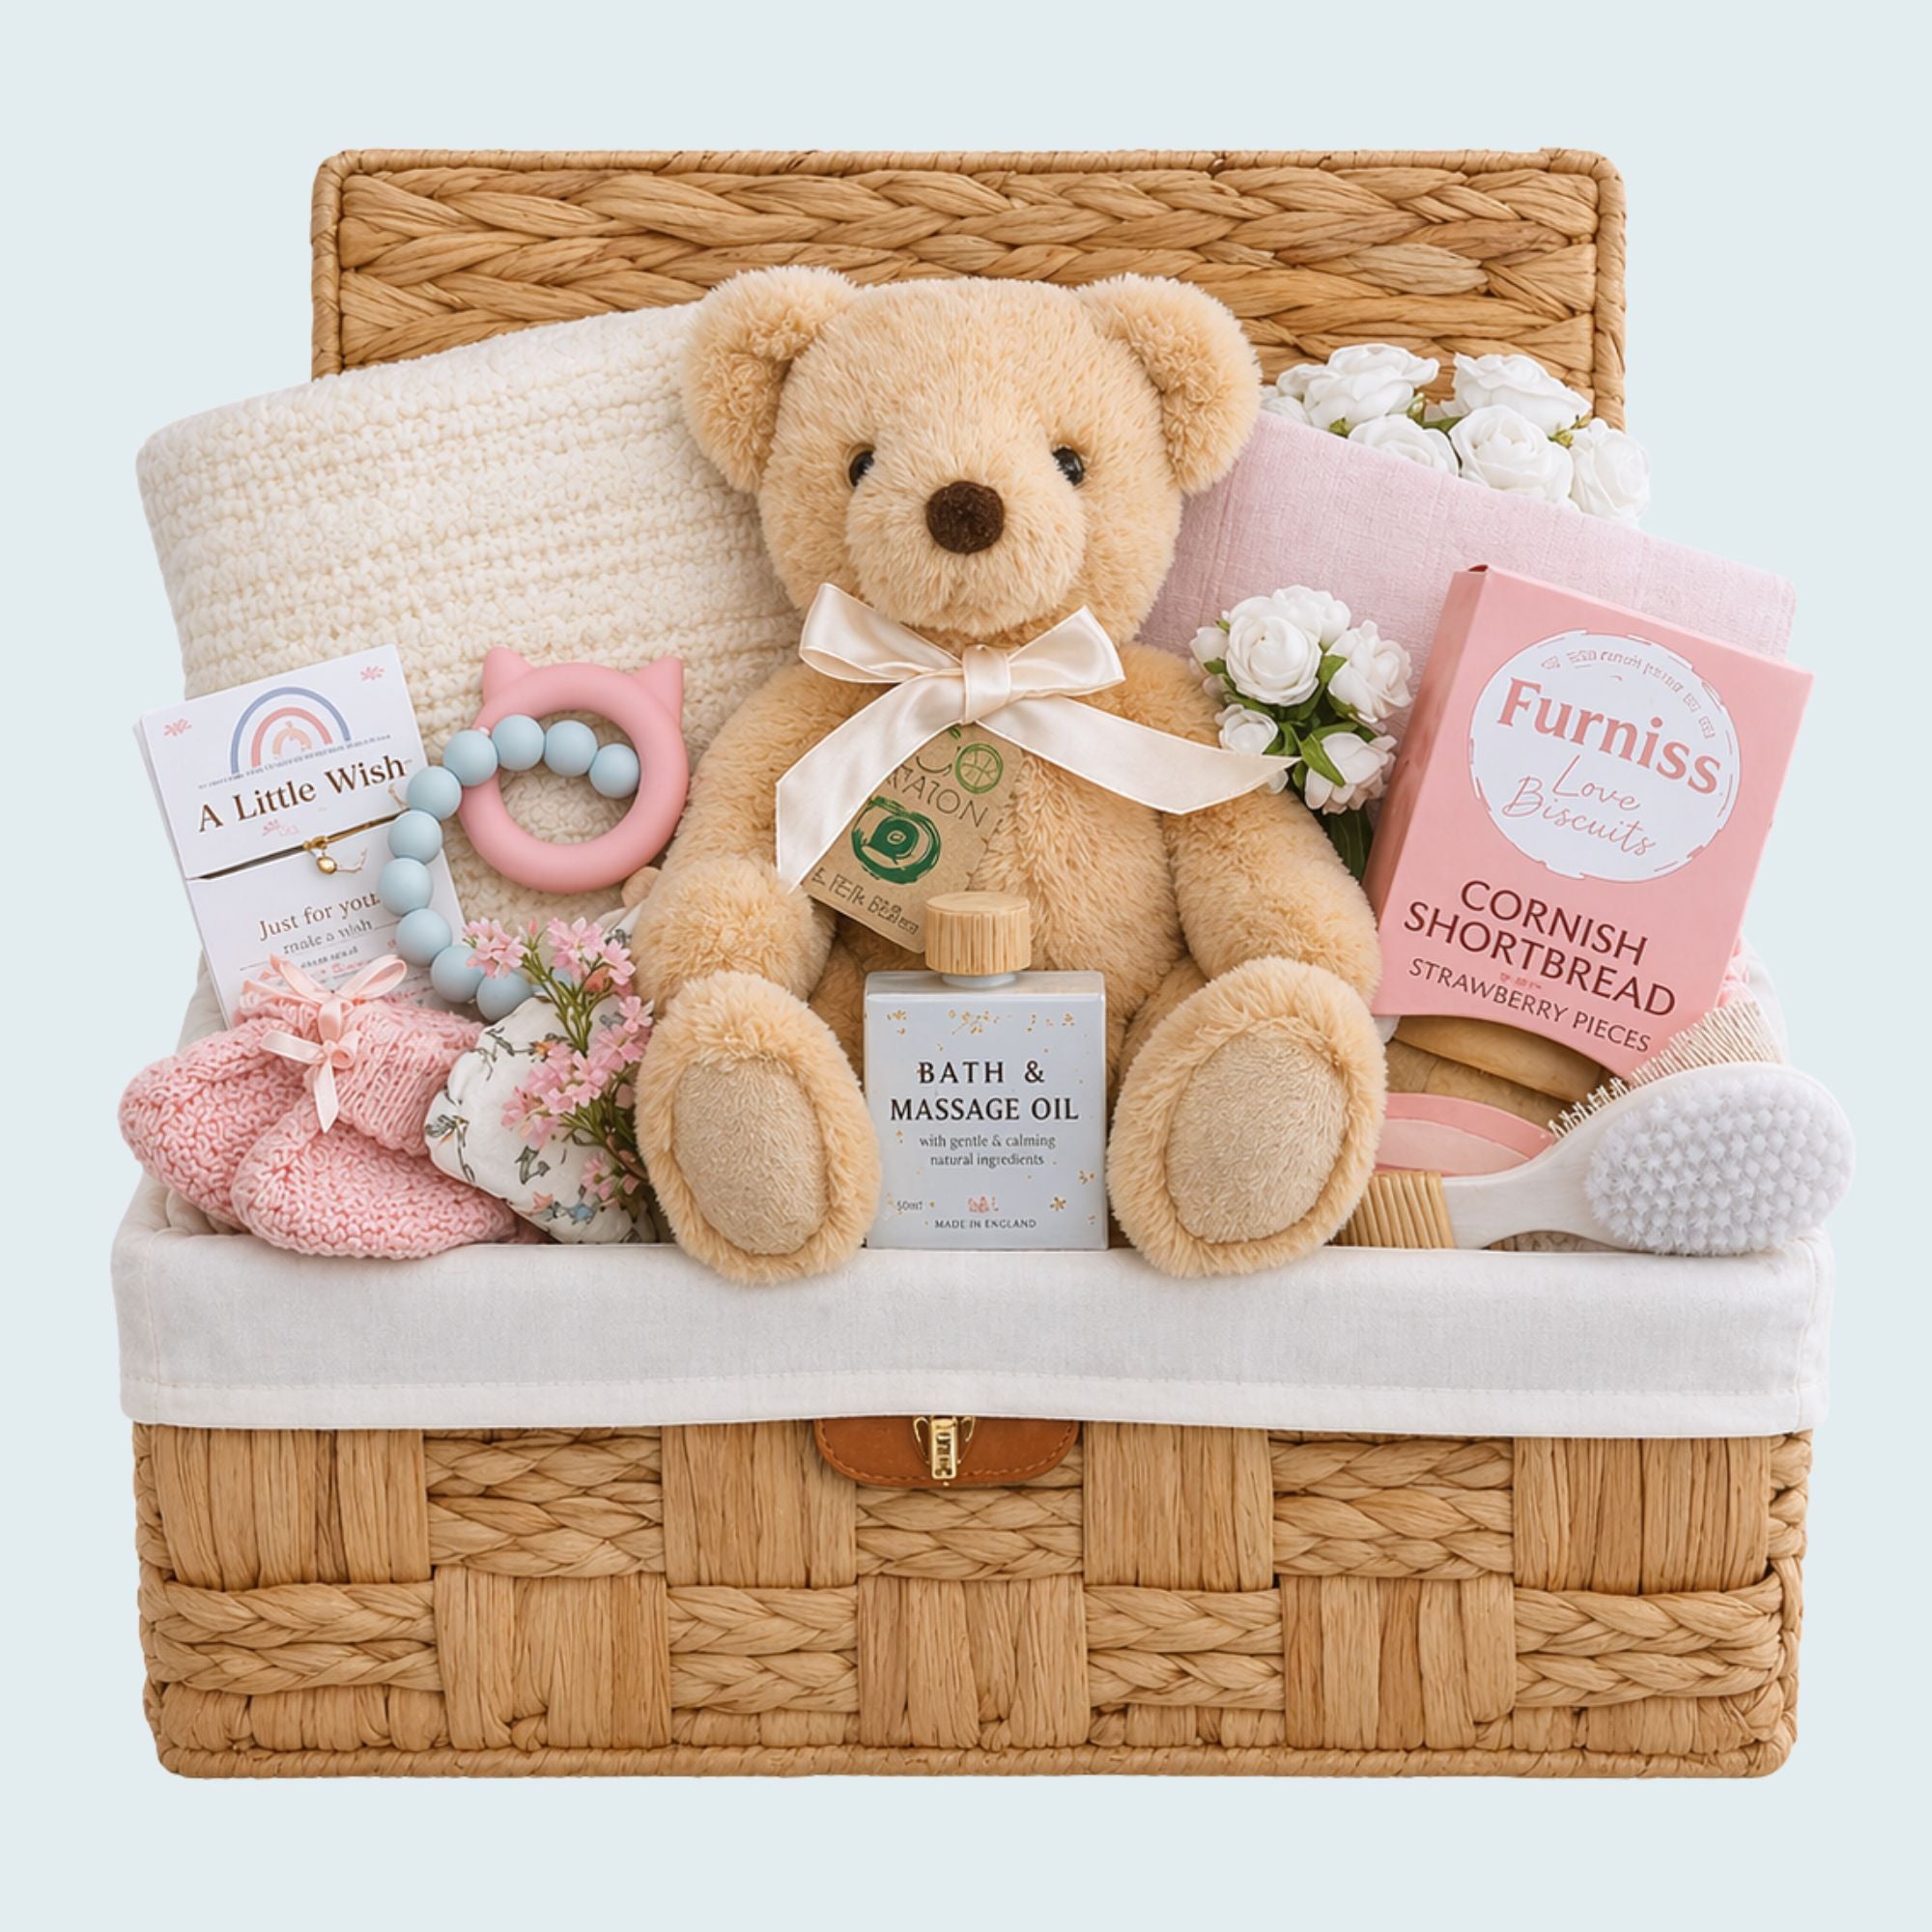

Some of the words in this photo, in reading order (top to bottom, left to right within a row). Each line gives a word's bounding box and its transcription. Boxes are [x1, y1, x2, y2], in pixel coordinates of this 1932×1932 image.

[1497, 677, 1720, 794] Furniss
[199, 805, 224, 832] A
[233, 780, 317, 821] Little
[325, 755, 407, 794] Wish
[1552, 754, 1640, 810] Love
[1502, 776, 1656, 856] Biscuits
[259, 914, 298, 941] Just
[304, 905, 333, 924] for
[1461, 880, 1648, 966] CORNISH
[1404, 901, 1676, 1015] SHORTBREAD
[1408, 957, 1568, 1022] STRAWBERRY
[1573, 1010, 1651, 1053] PIECES
[919, 1061, 1005, 1084] BATH
[1024, 1060, 1045, 1084] &
[890, 1098, 1020, 1122] MASSAGE
[1031, 1098, 1079, 1122] OIL
[920, 1135, 947, 1148] with
[950, 1134, 988, 1151] gentle
[992, 1135, 1002, 1148] &
[1006, 1134, 1056, 1151] calming
[930, 1154, 974, 1166] natural
[977, 1154, 1044, 1169] ingredients
[935, 1220, 965, 1229] MADE
[970, 1220, 981, 1229] IN
[985, 1220, 1037, 1229] ENGLAND
